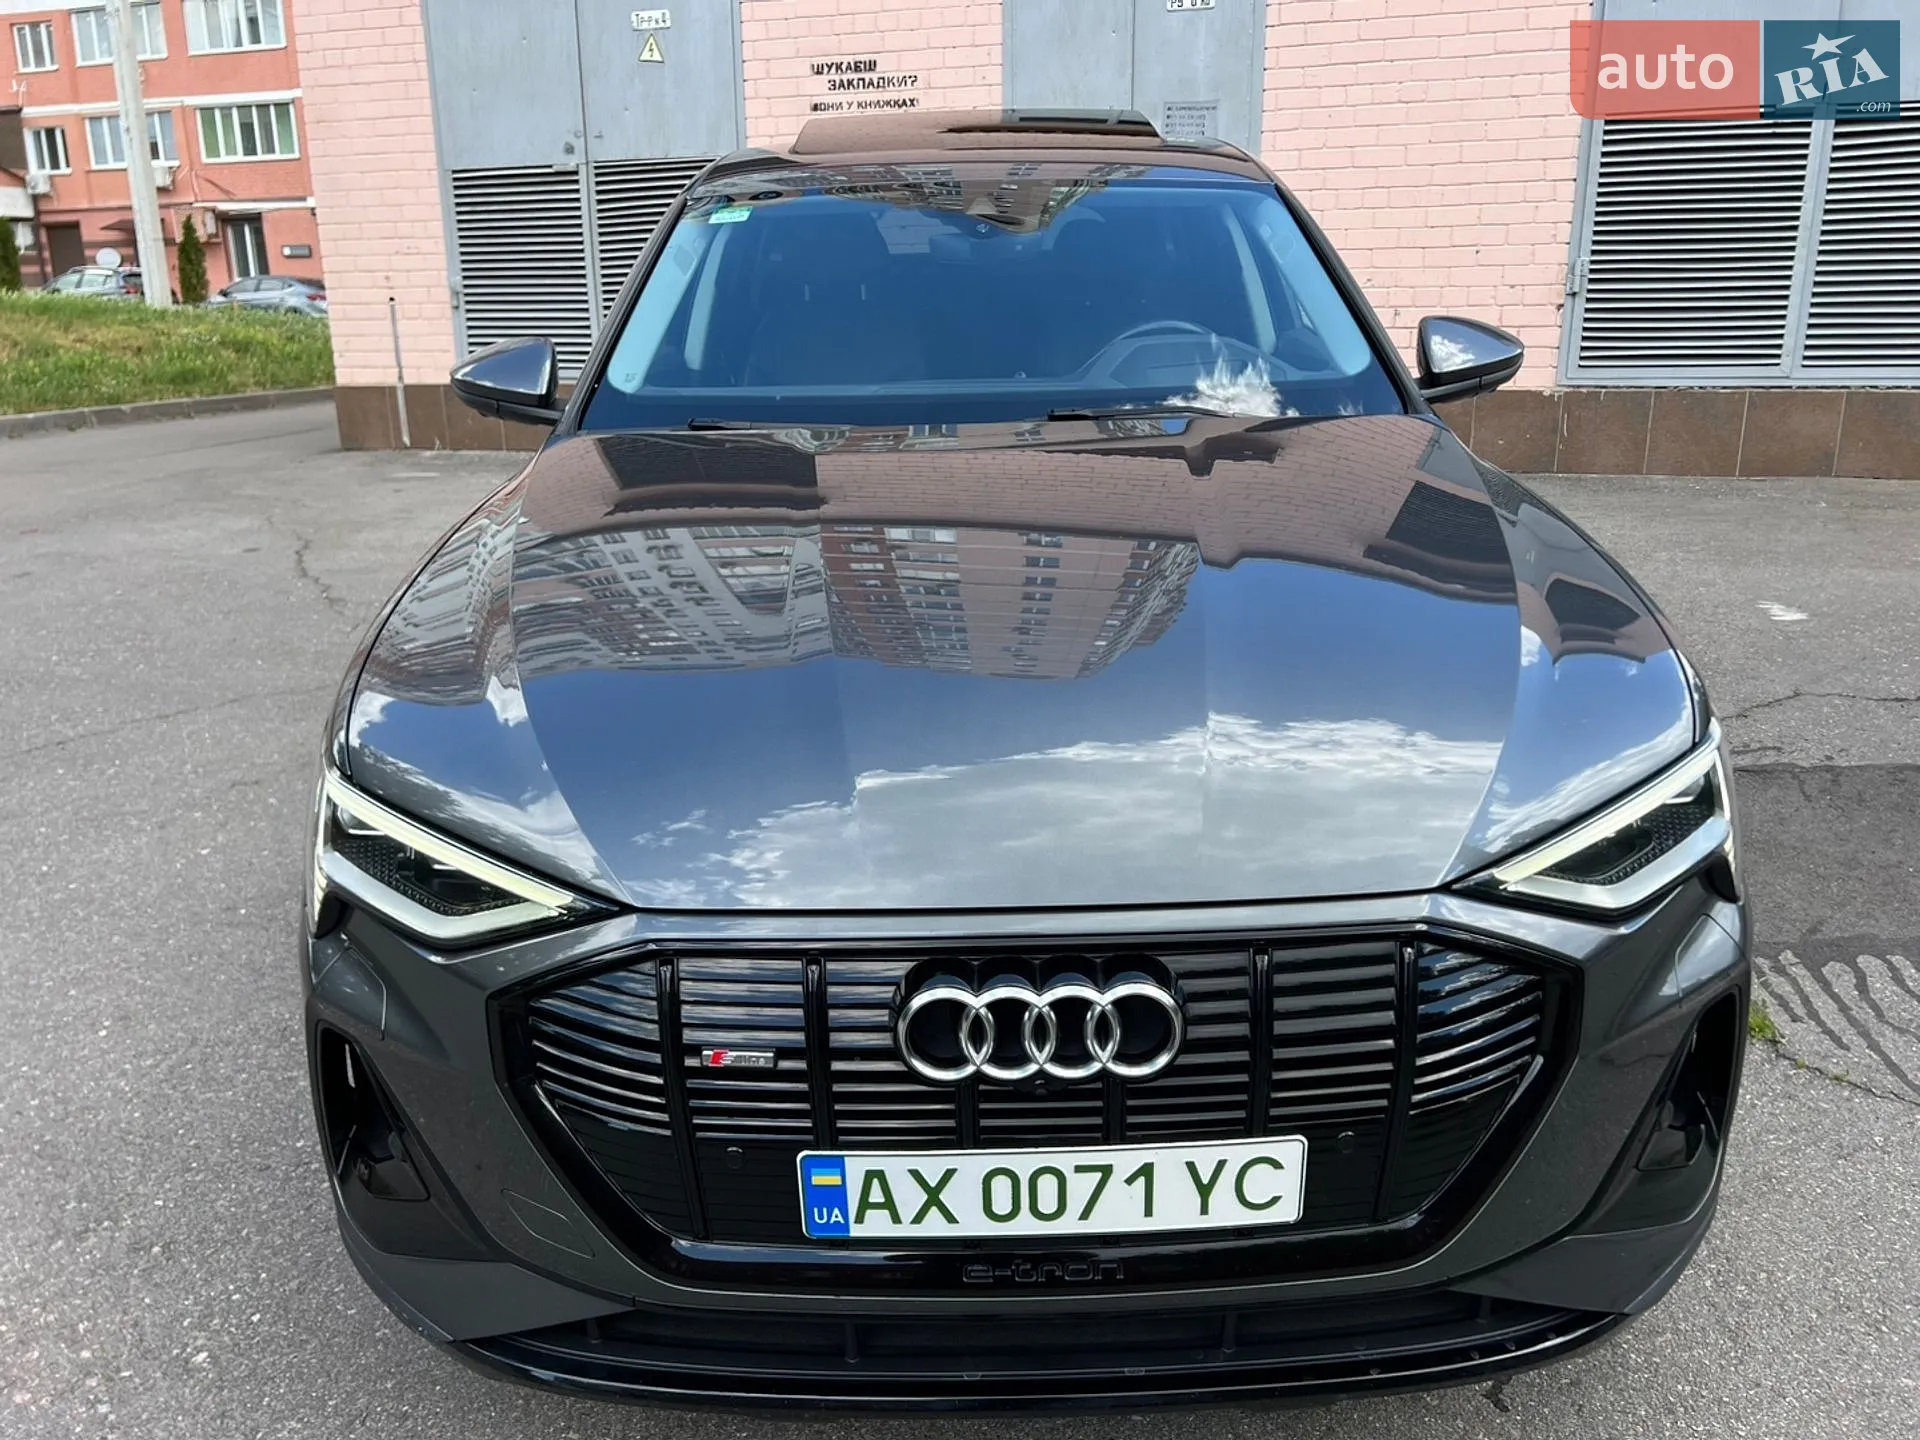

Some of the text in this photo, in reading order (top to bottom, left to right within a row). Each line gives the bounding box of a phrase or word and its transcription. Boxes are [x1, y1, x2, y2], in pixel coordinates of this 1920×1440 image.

[853, 1155, 1286, 1225] AX 0071 YC
[813, 1206, 845, 1225] UA
[962, 1259, 1125, 1283] e-tron
